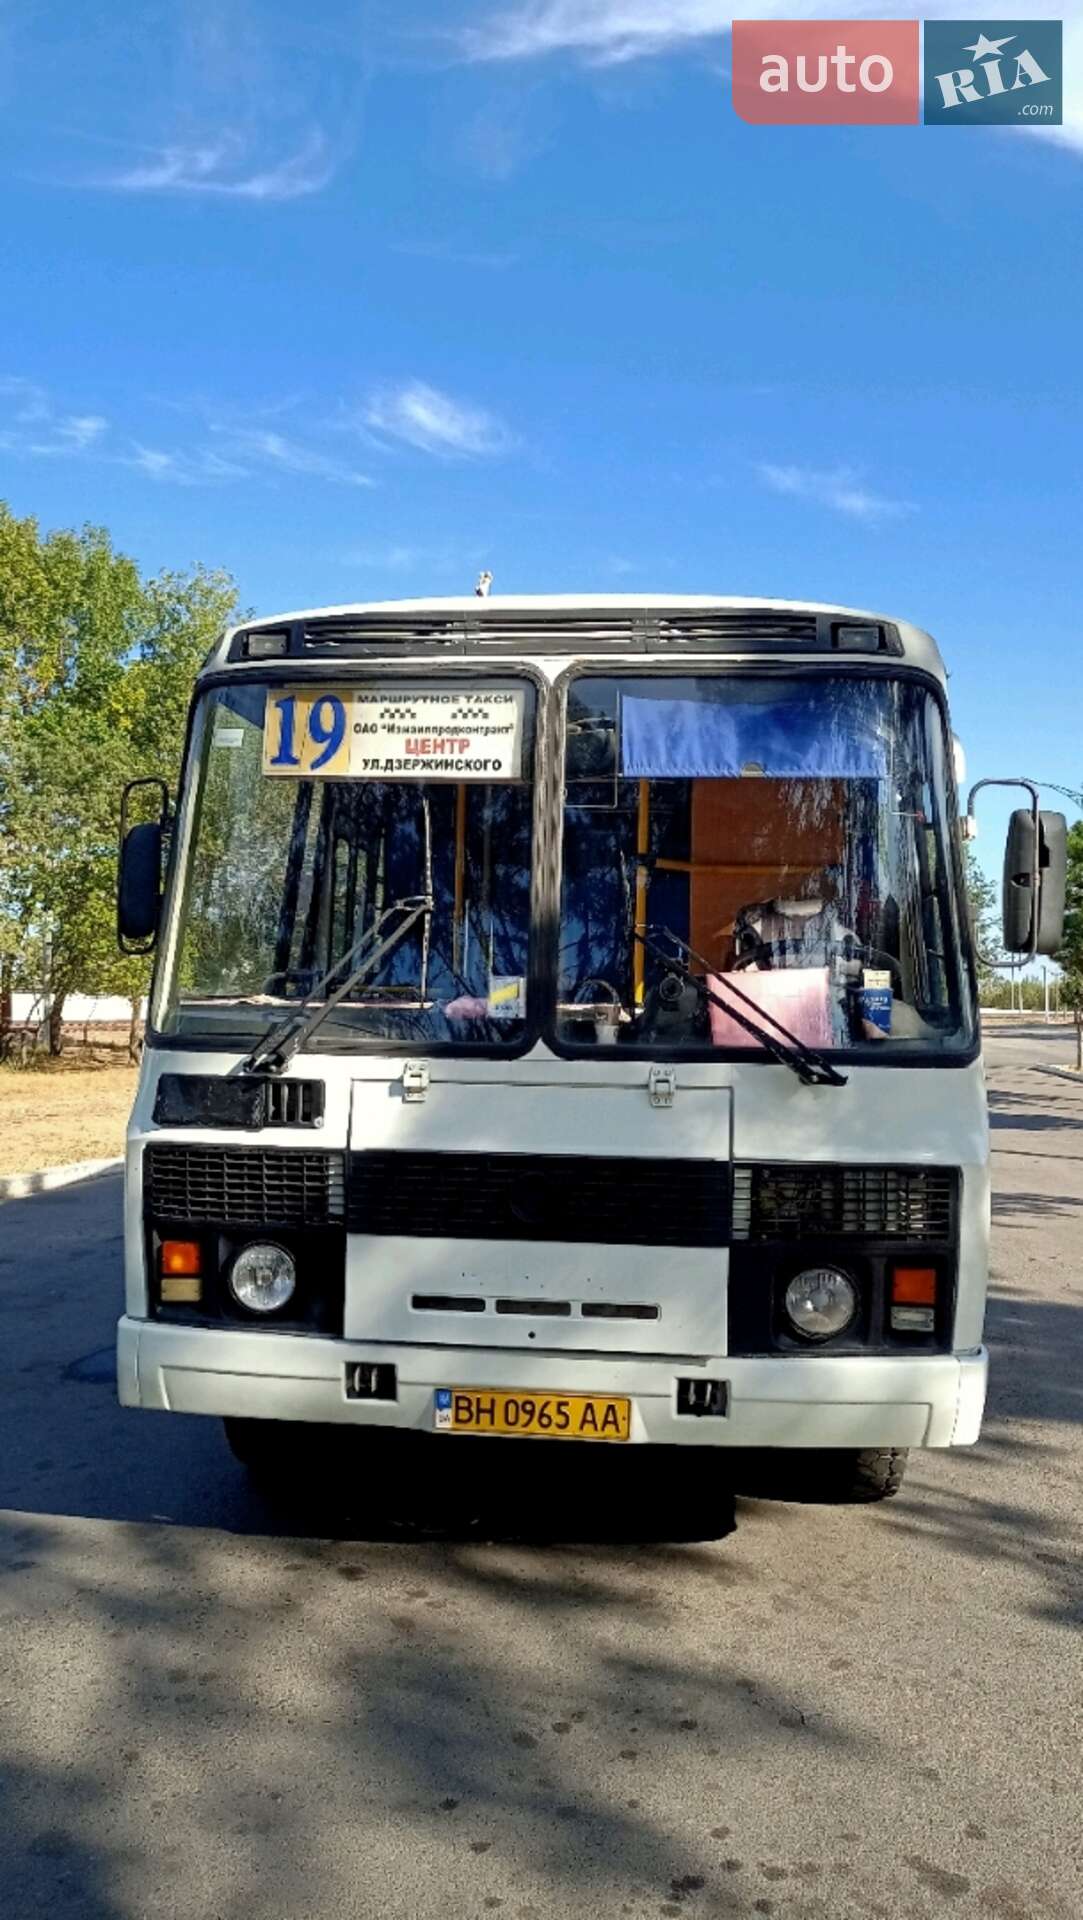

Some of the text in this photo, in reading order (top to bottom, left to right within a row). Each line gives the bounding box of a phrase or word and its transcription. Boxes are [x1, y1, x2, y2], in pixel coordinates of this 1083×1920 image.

[357, 694, 514, 704] МАРШРУТНОЕ ТАКСИ
[270, 694, 347, 770] 19
[353, 722, 378, 734] ОАО
[404, 738, 471, 756] ЦЕНТР
[362, 758, 502, 773] УЛ.ДЗЕРЖИНСКОГО
[504, 1398, 570, 1430] 0965
[579, 1402, 620, 1433] AA
